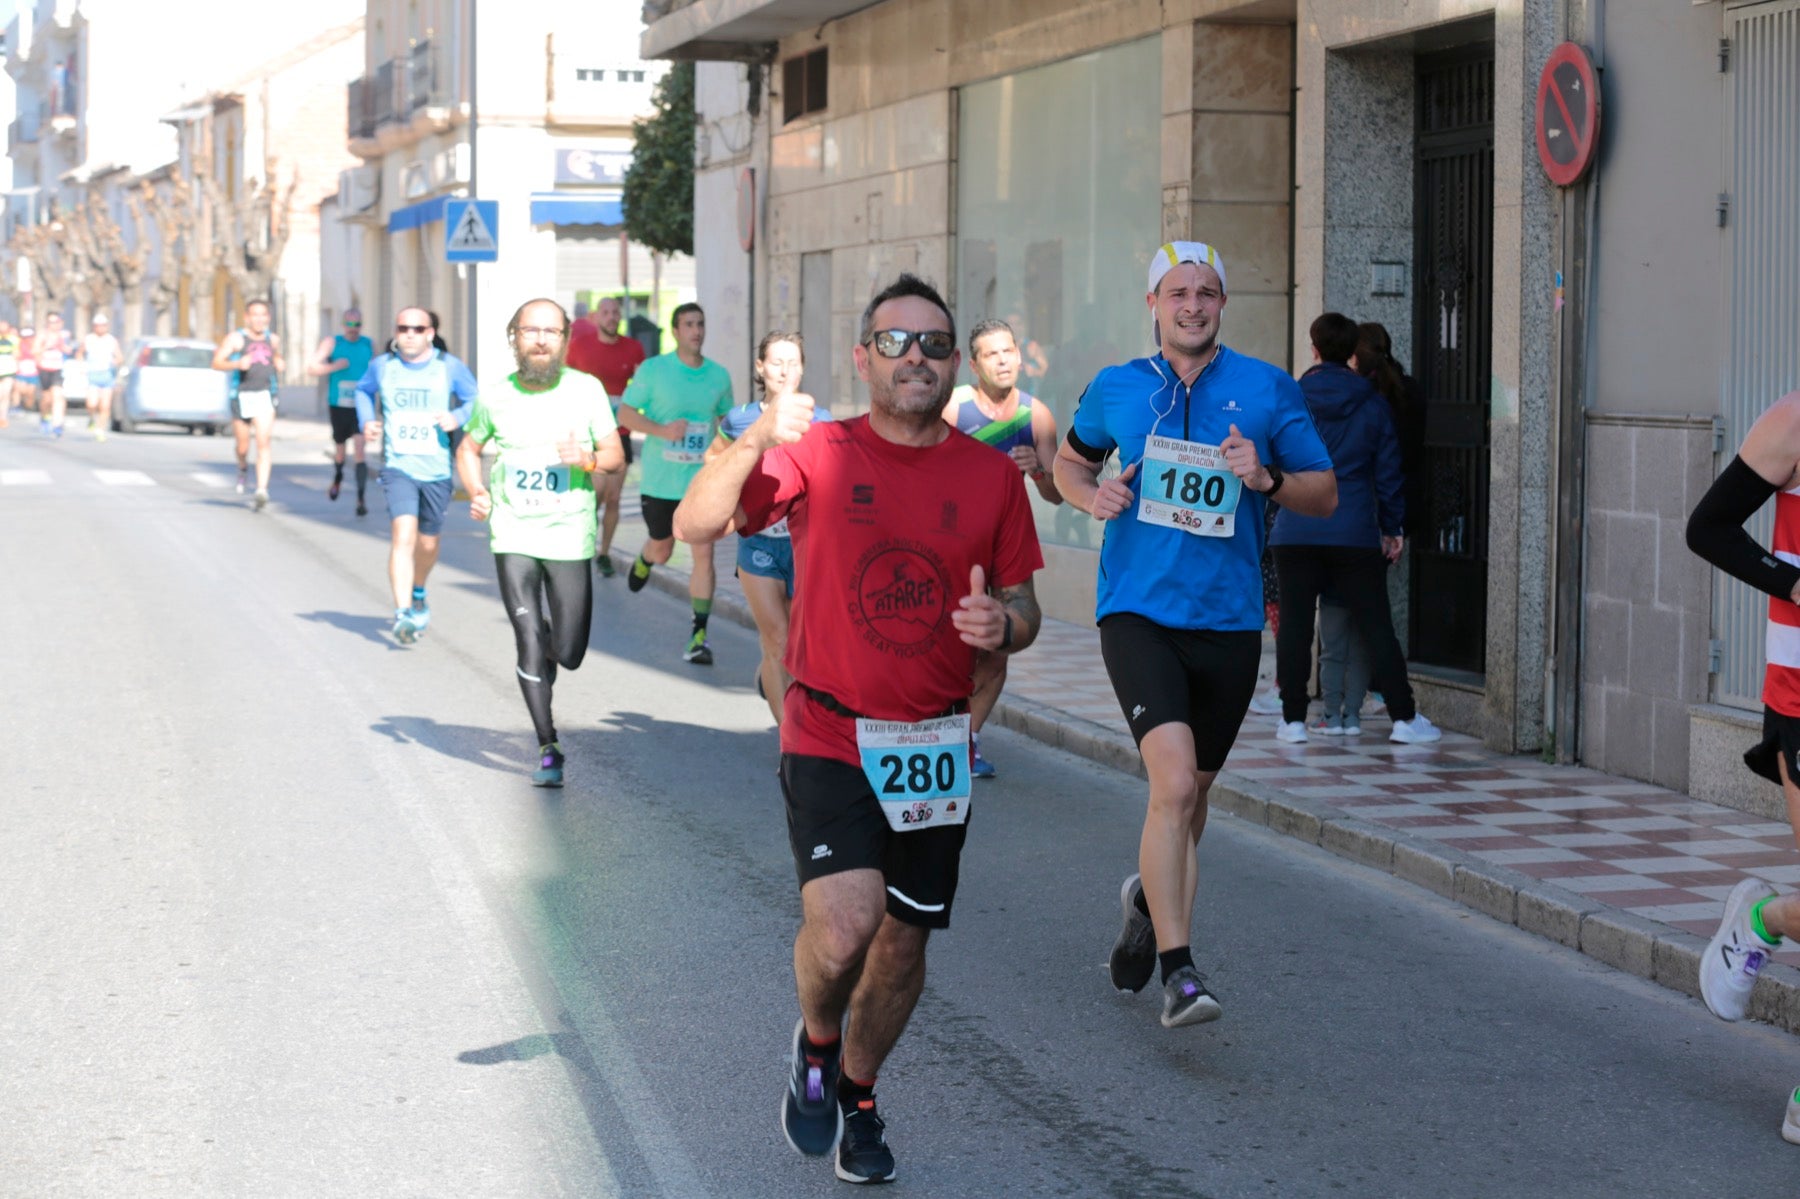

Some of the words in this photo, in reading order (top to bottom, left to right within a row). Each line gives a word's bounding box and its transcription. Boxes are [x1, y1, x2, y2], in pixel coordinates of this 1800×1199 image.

[399, 425, 430, 441] 829
[1171, 442, 1188, 452] GRAN
[1189, 445, 1212, 456] PREMIO
[516, 469, 558, 491] 220
[1160, 468, 1225, 507] 180
[875, 578, 935, 612] ATARFE
[887, 723, 909, 734] GRAN
[943, 718, 965, 730] FONDO
[880, 752, 955, 794] 280
